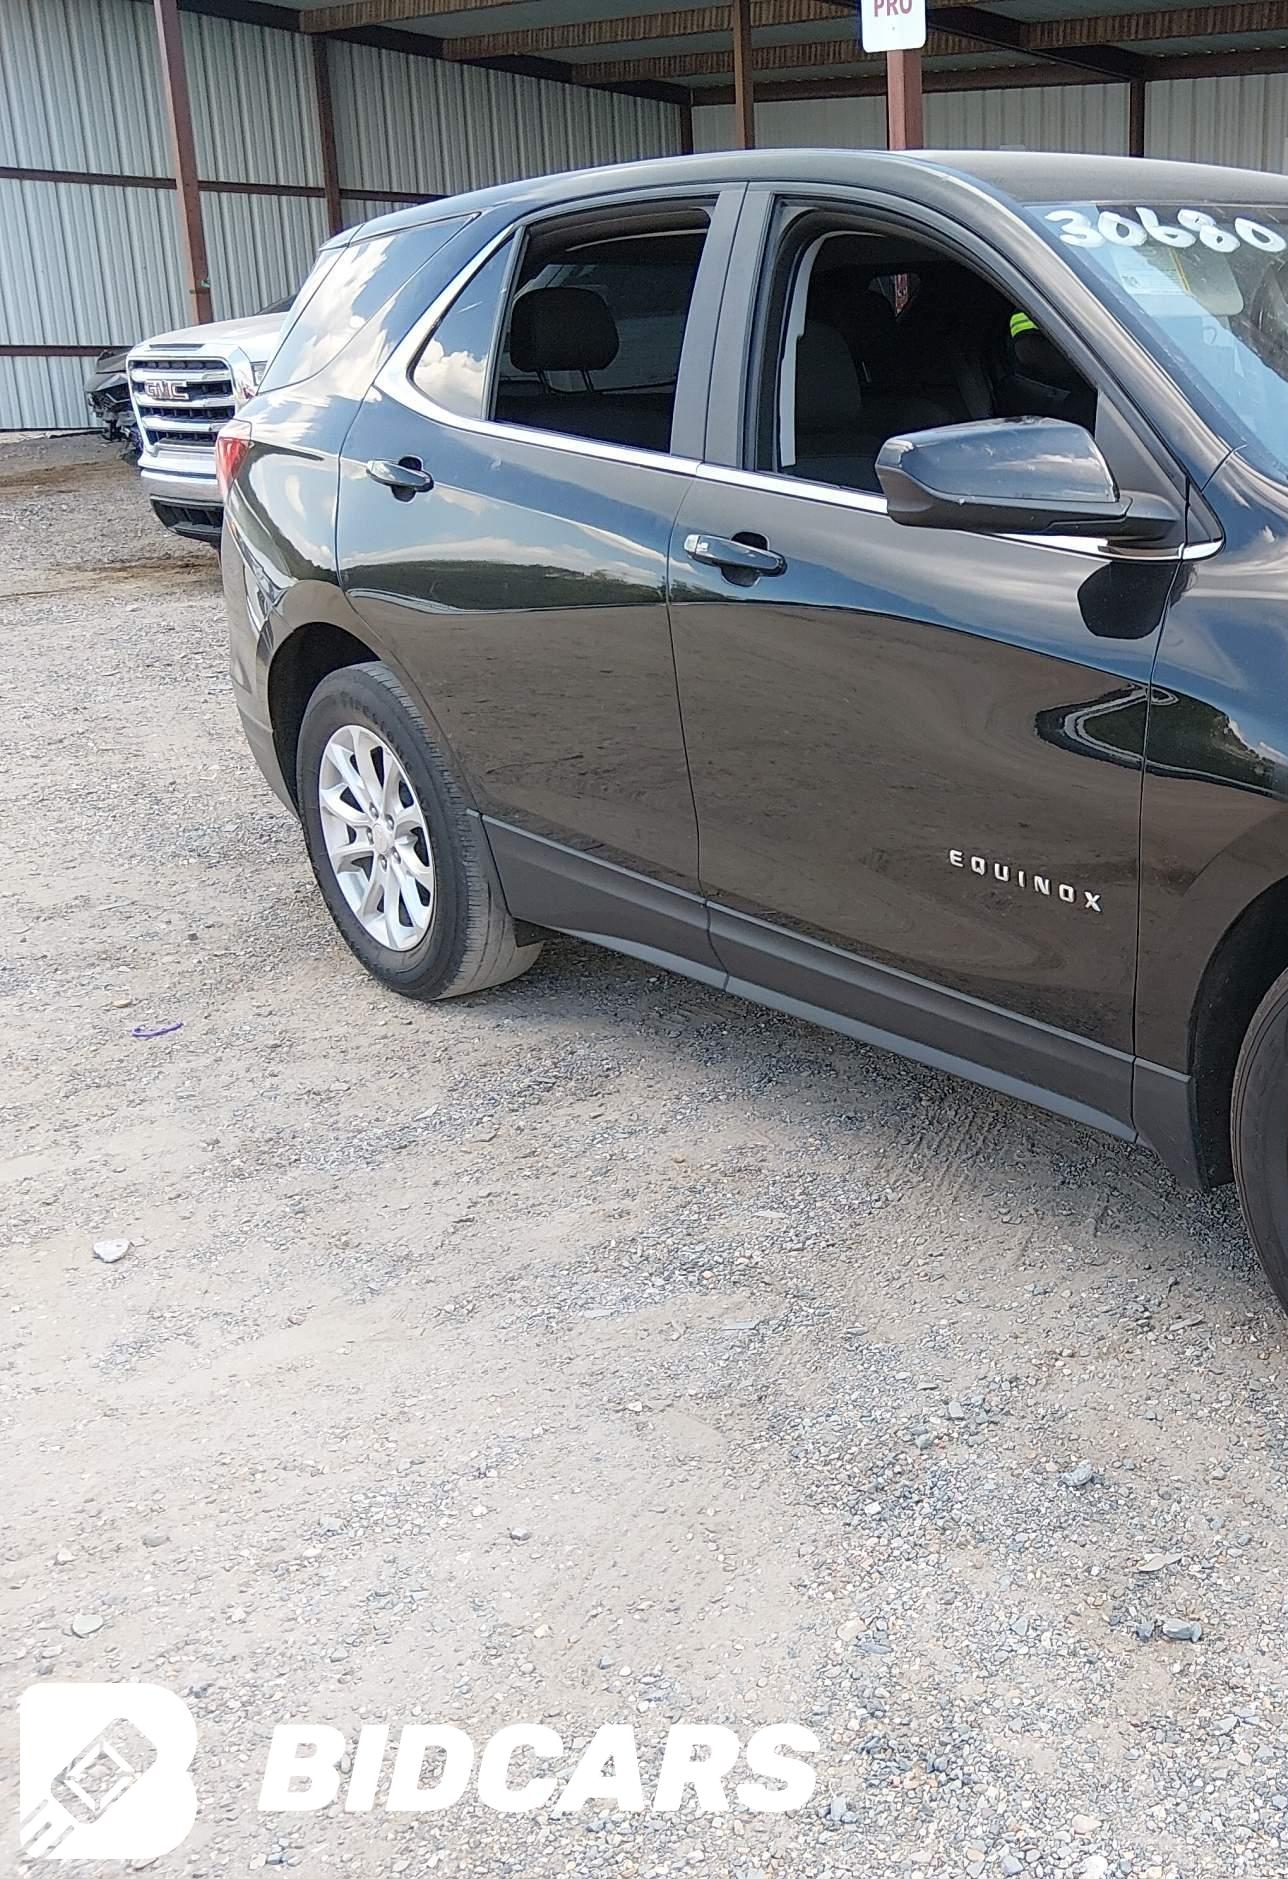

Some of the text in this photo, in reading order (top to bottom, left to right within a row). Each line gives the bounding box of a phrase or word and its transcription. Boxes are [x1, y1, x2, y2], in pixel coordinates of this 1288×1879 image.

[873, 0, 913, 17] PRO
[1044, 206, 1287, 253] 30680
[144, 379, 190, 400] GMC
[949, 849, 1102, 912] EQUINOX
